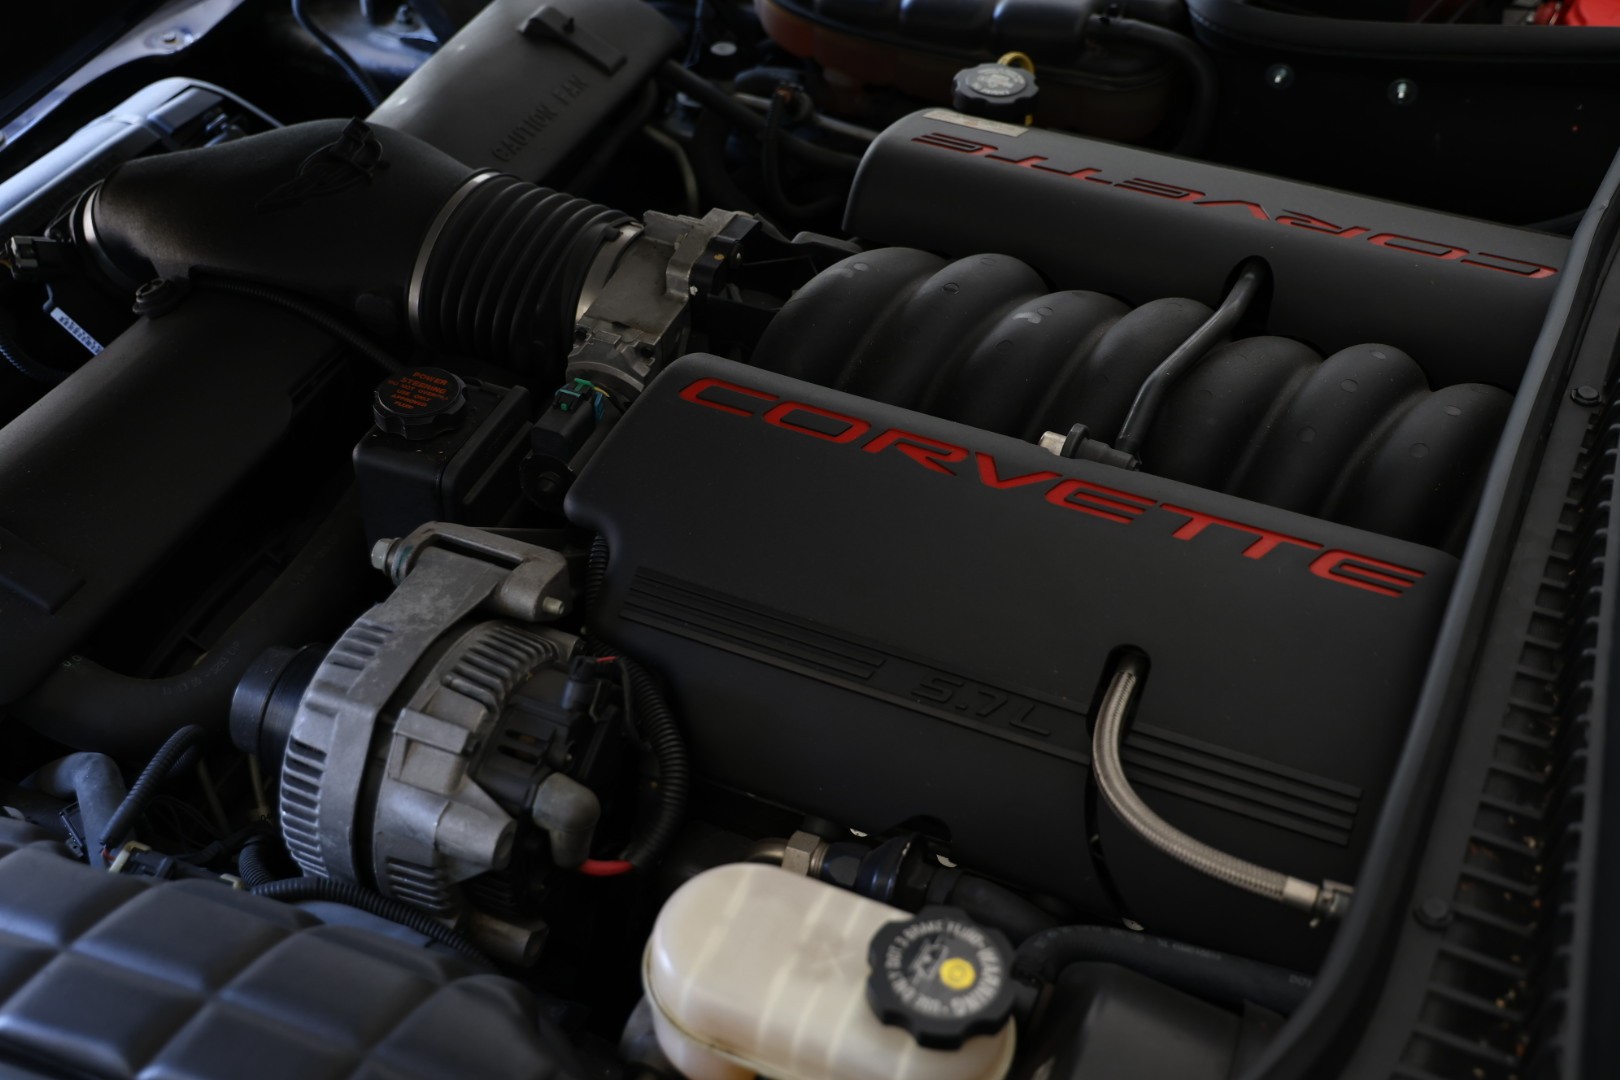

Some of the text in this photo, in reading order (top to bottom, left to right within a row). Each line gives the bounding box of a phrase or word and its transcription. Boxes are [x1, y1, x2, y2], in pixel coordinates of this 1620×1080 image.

[491, 74, 589, 162] CAUTION FAN
[911, 132, 1558, 280] CORVETTE
[390, 393, 428, 407] APPROVED
[399, 376, 449, 395] STEERING
[411, 371, 449, 386] POWER
[678, 377, 1427, 598] CORVETTE
[911, 672, 1050, 736] 5.7L
